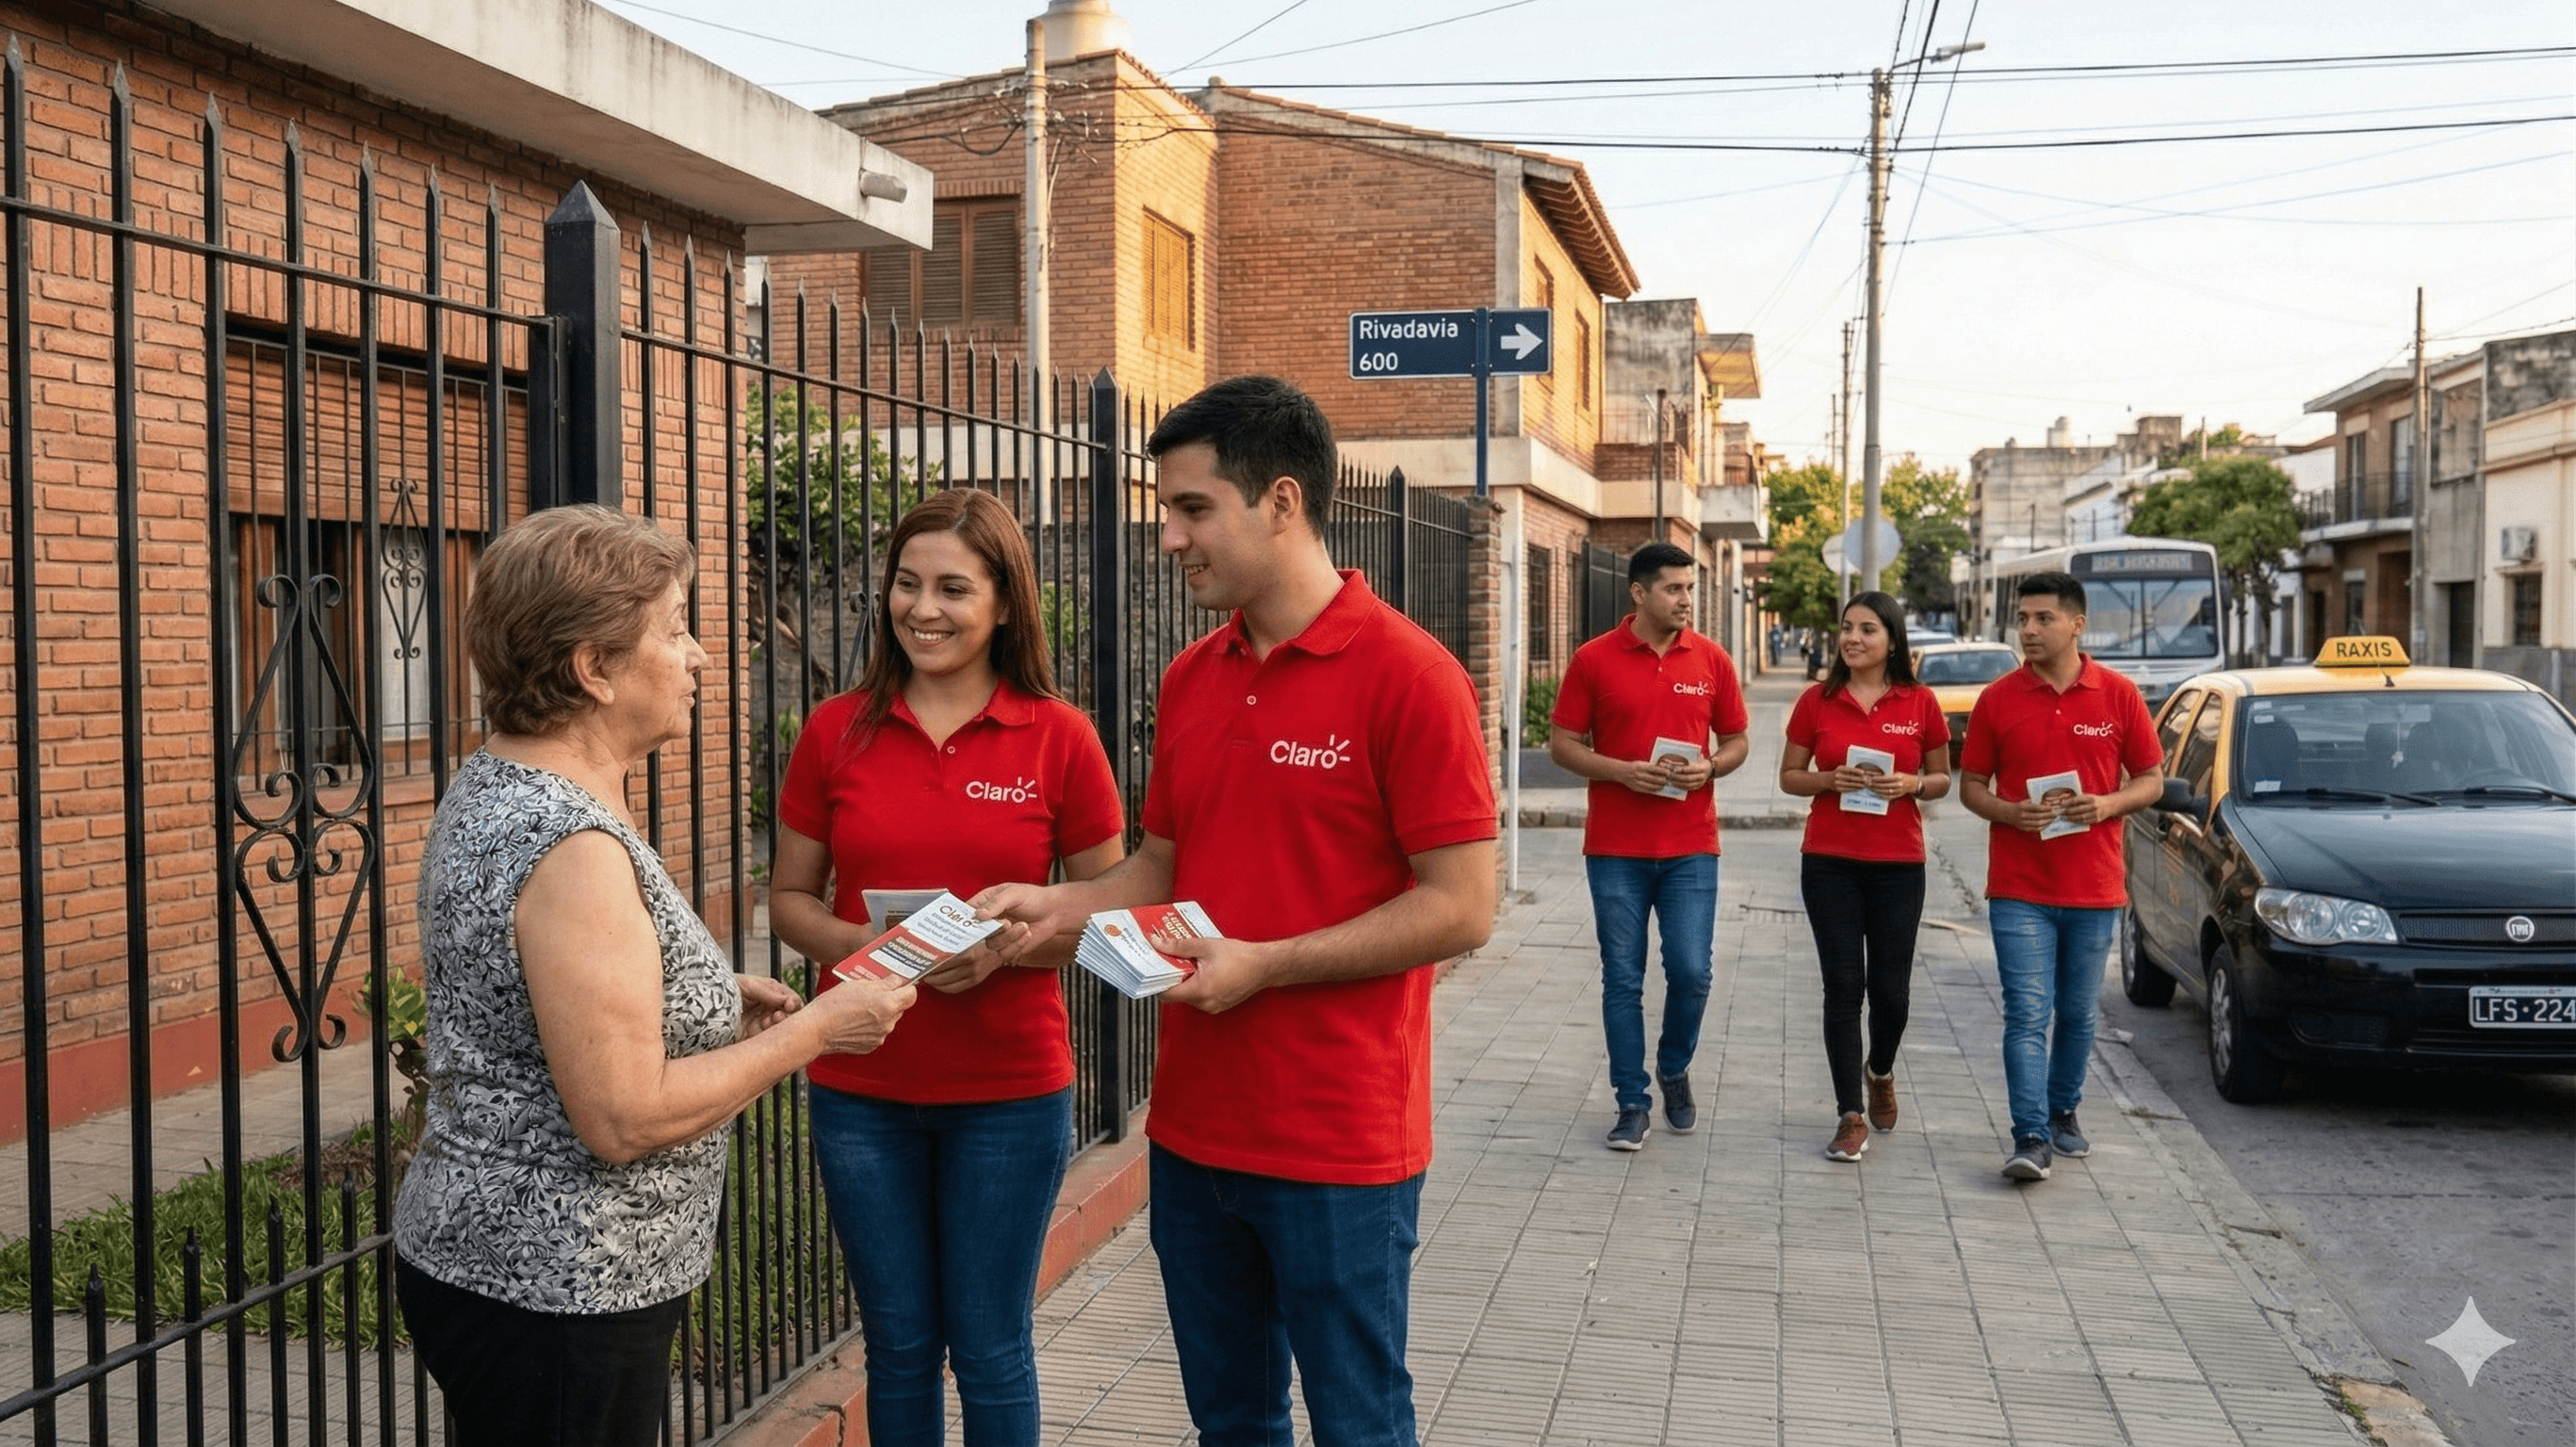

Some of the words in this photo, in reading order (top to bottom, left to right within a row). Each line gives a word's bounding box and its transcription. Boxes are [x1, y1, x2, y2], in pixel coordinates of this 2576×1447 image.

[1359, 318, 1459, 339] Rivadavia
[1359, 352, 1398, 371] 600
[2336, 642, 2392, 658] RAXIS
[1882, 722, 1916, 735] Claro
[2073, 724, 2109, 737] Claro
[1270, 740, 1338, 770] Claro
[966, 780, 1027, 804] Claro
